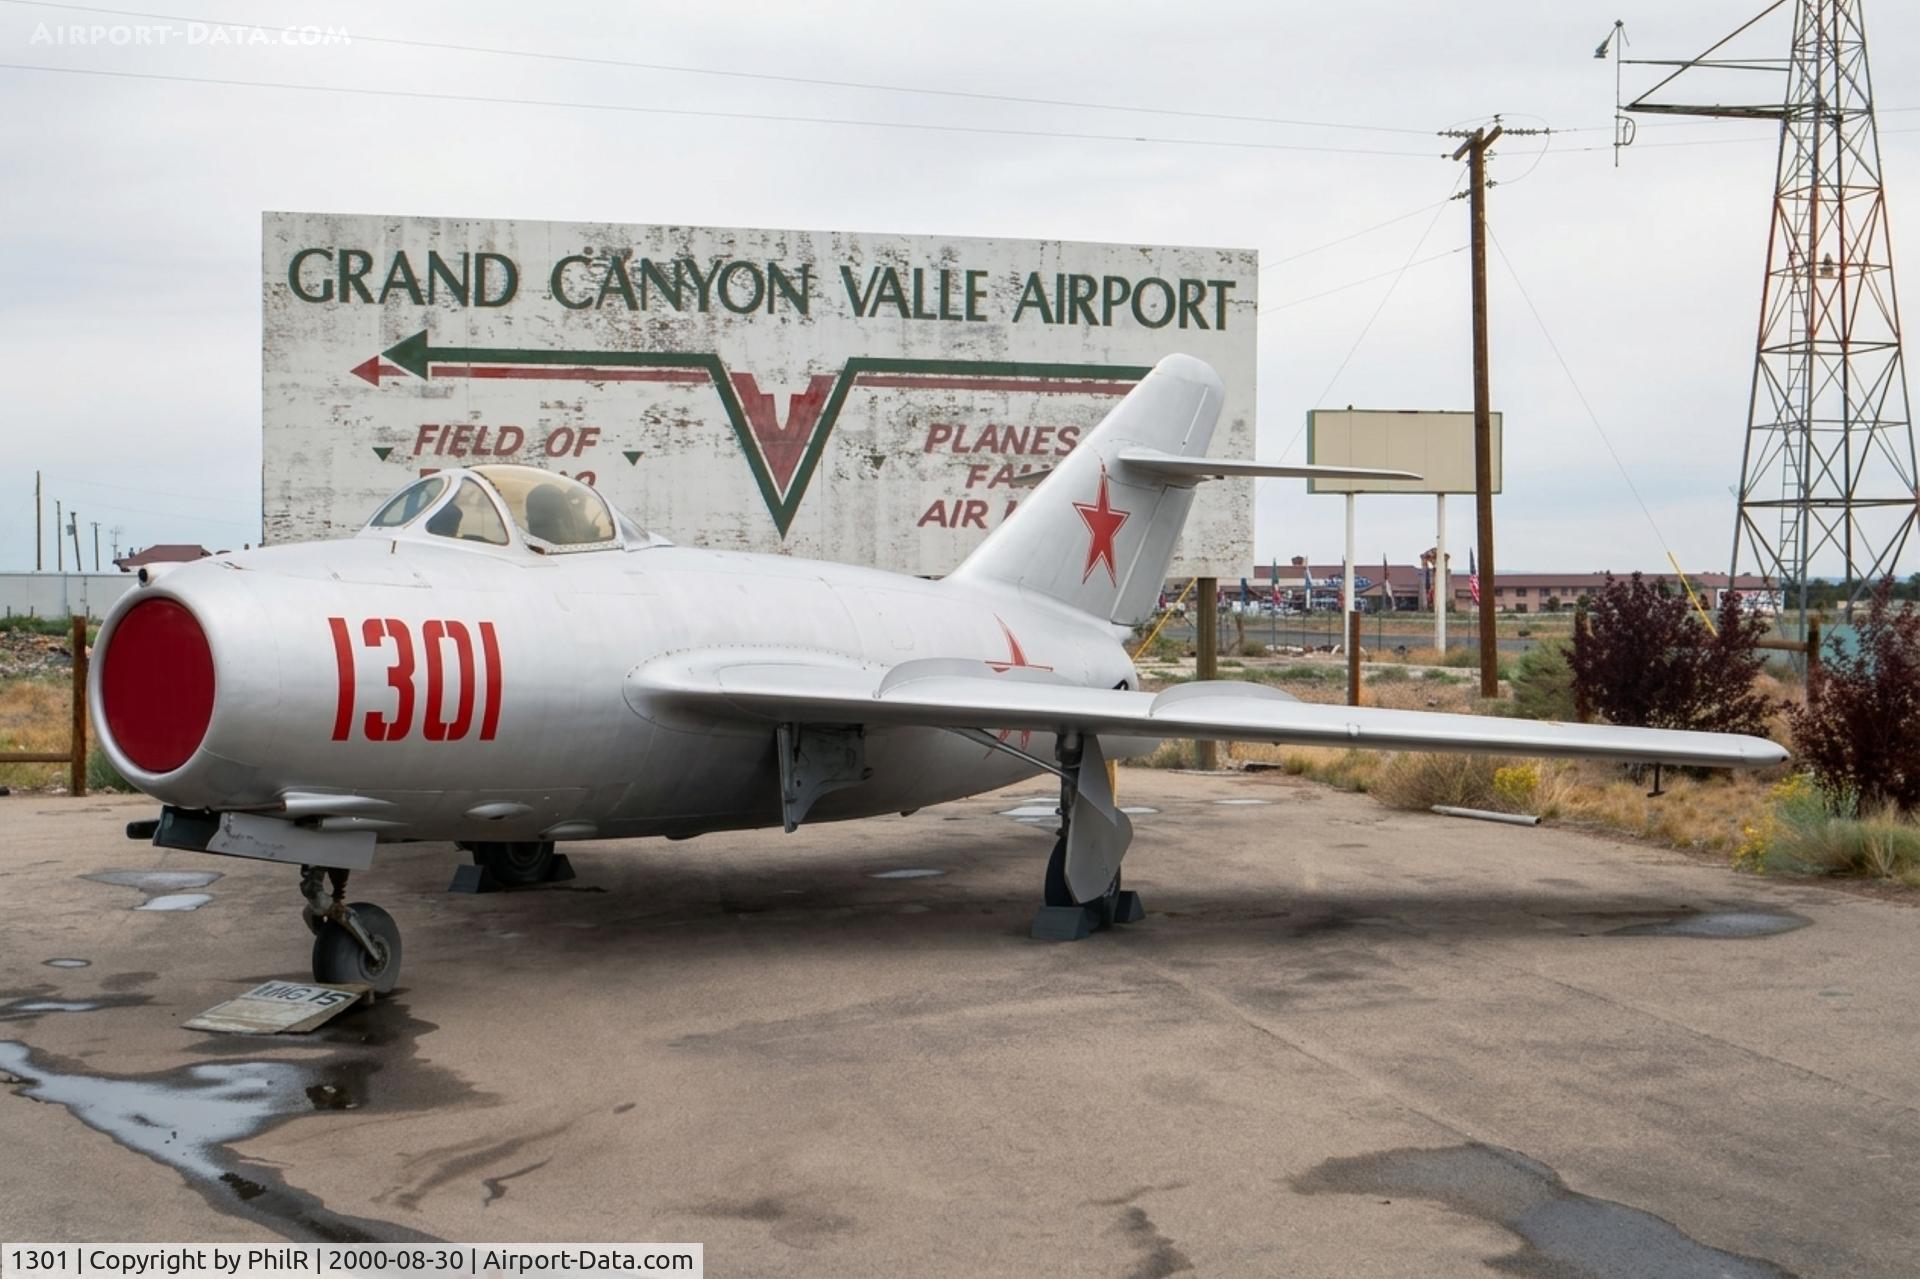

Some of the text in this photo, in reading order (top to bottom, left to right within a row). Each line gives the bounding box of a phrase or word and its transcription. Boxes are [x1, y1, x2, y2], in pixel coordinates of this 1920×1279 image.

[288, 248, 1236, 331] GRAND CANYON VALLE AIRPORT
[413, 424, 601, 457] FIELD OF
[924, 423, 1081, 456] PLANES
[917, 499, 988, 529] AIR
[327, 617, 502, 741] 1301
[307, 990, 353, 1006] 15
